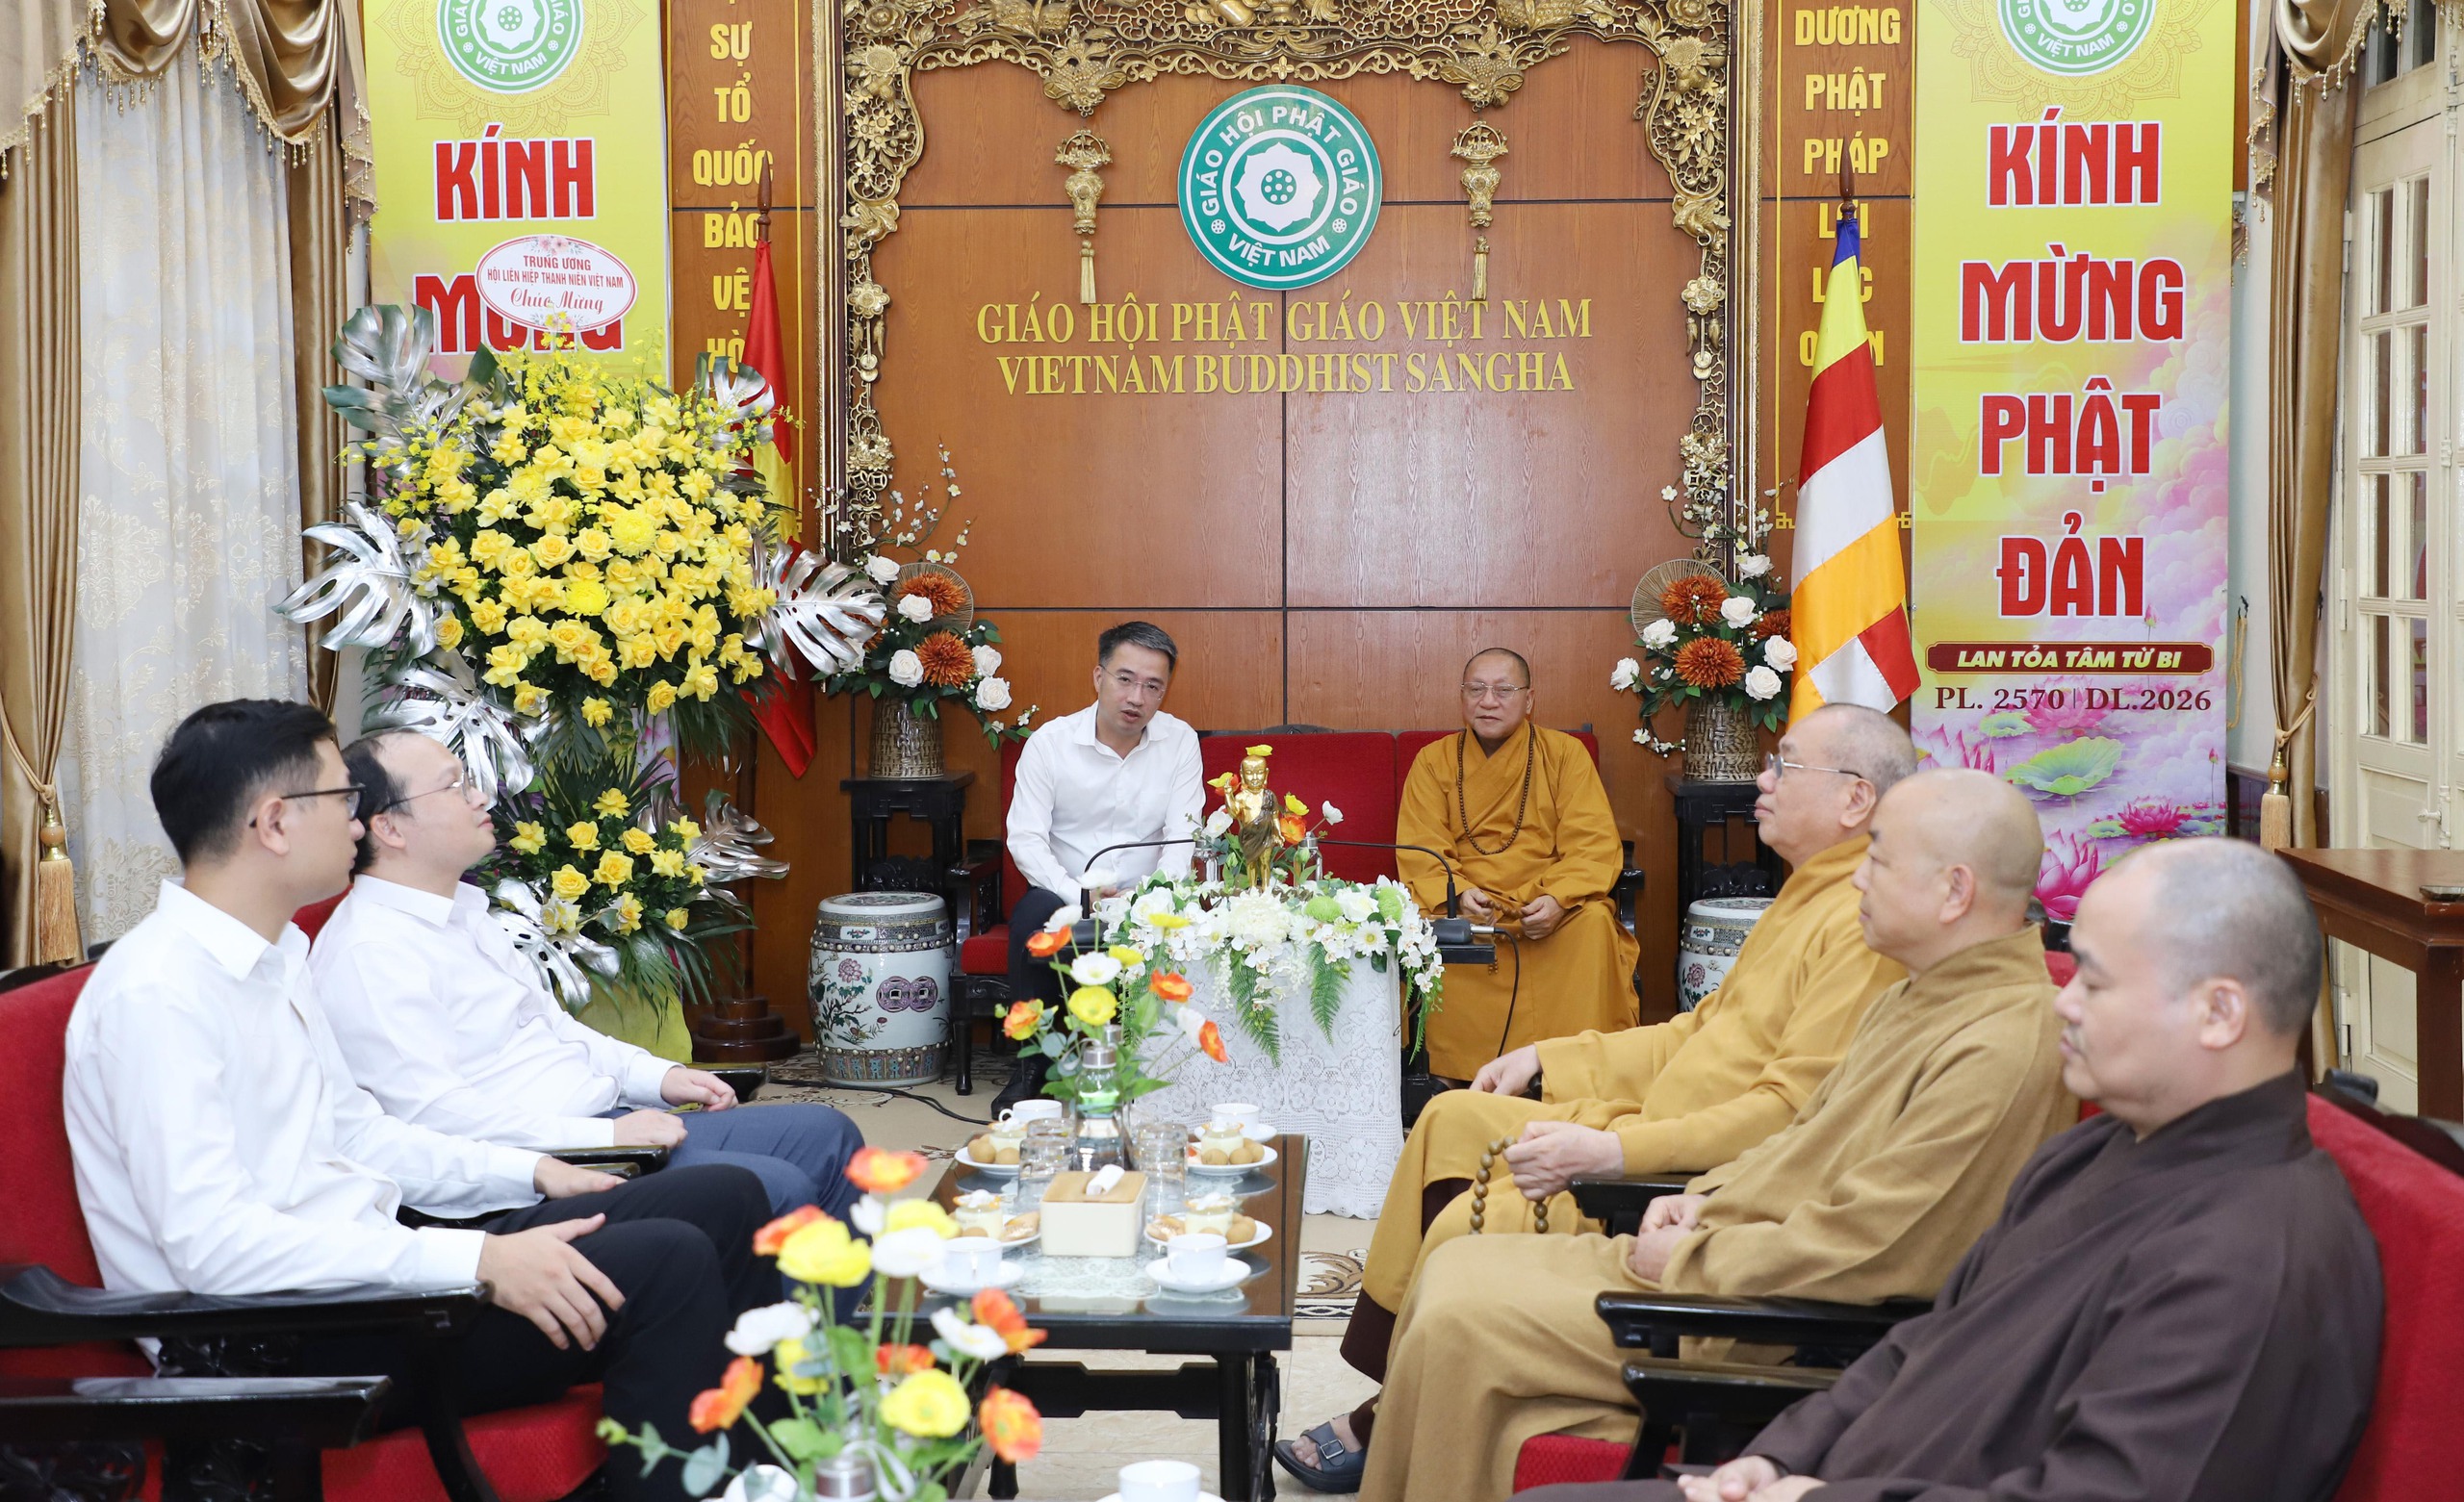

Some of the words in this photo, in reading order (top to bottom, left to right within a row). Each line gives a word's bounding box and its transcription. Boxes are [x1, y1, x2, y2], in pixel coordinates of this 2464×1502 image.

[550, 0, 569, 36] IÁO
[1795, 5, 1901, 46] DƯƠNG
[475, 51, 509, 75] VIỆT
[511, 52, 548, 75] NAM
[710, 21, 754, 67] SỰ
[2037, 32, 2073, 58] VIỆT
[2075, 33, 2116, 58] NAM
[714, 72, 752, 123] TỔ
[1805, 66, 1886, 117] PHẬT
[435, 123, 596, 221] KÍNH
[1196, 149, 1223, 216] GIÁO
[1219, 109, 1264, 146] HỘI
[1272, 106, 1342, 144] PHẬT
[1336, 148, 1365, 216] GIÁO
[1987, 107, 2161, 206] KÍNH
[1819, 199, 1869, 239] LI
[523, 255, 558, 268] TRUNG
[561, 257, 591, 270] ƯƠNG
[1227, 233, 1276, 267] VIỆT
[1279, 235, 1331, 267] NAM
[487, 267, 500, 284] HỘI
[502, 267, 520, 282] LIÊN
[522, 269, 539, 286] HIỆP
[541, 272, 566, 285] THANH
[568, 271, 587, 286] NIÊN
[588, 272, 603, 290] VIỆT
[605, 275, 624, 288] NAM
[713, 267, 751, 318] VỆ
[1812, 267, 1873, 303] LC
[1960, 243, 2184, 342] MỪNG
[510, 288, 552, 308] Chúc
[555, 291, 603, 316] Mừng
[977, 291, 1075, 344] GIÁO
[1088, 292, 1160, 350] HỘI
[1170, 290, 1273, 349] PHẬT
[1287, 289, 1386, 342] GIÁO
[1397, 290, 1489, 348] VIỆT
[1502, 298, 1593, 339] NAM
[996, 354, 1187, 395] VIETNAM
[1194, 352, 1399, 394] BUDDHIST
[1405, 351, 1575, 393] SANGHA
[1981, 377, 2162, 492] PHẬT
[1996, 511, 2145, 617] ĐẢN
[1957, 650, 2005, 668] LAN
[2011, 645, 2059, 668] TỎA
[2066, 648, 2118, 668] TÂM
[2121, 647, 2155, 668] TỪ
[2156, 650, 2182, 668] BI
[1935, 686, 1984, 710] PL.
[1993, 688, 2065, 710] 2570
